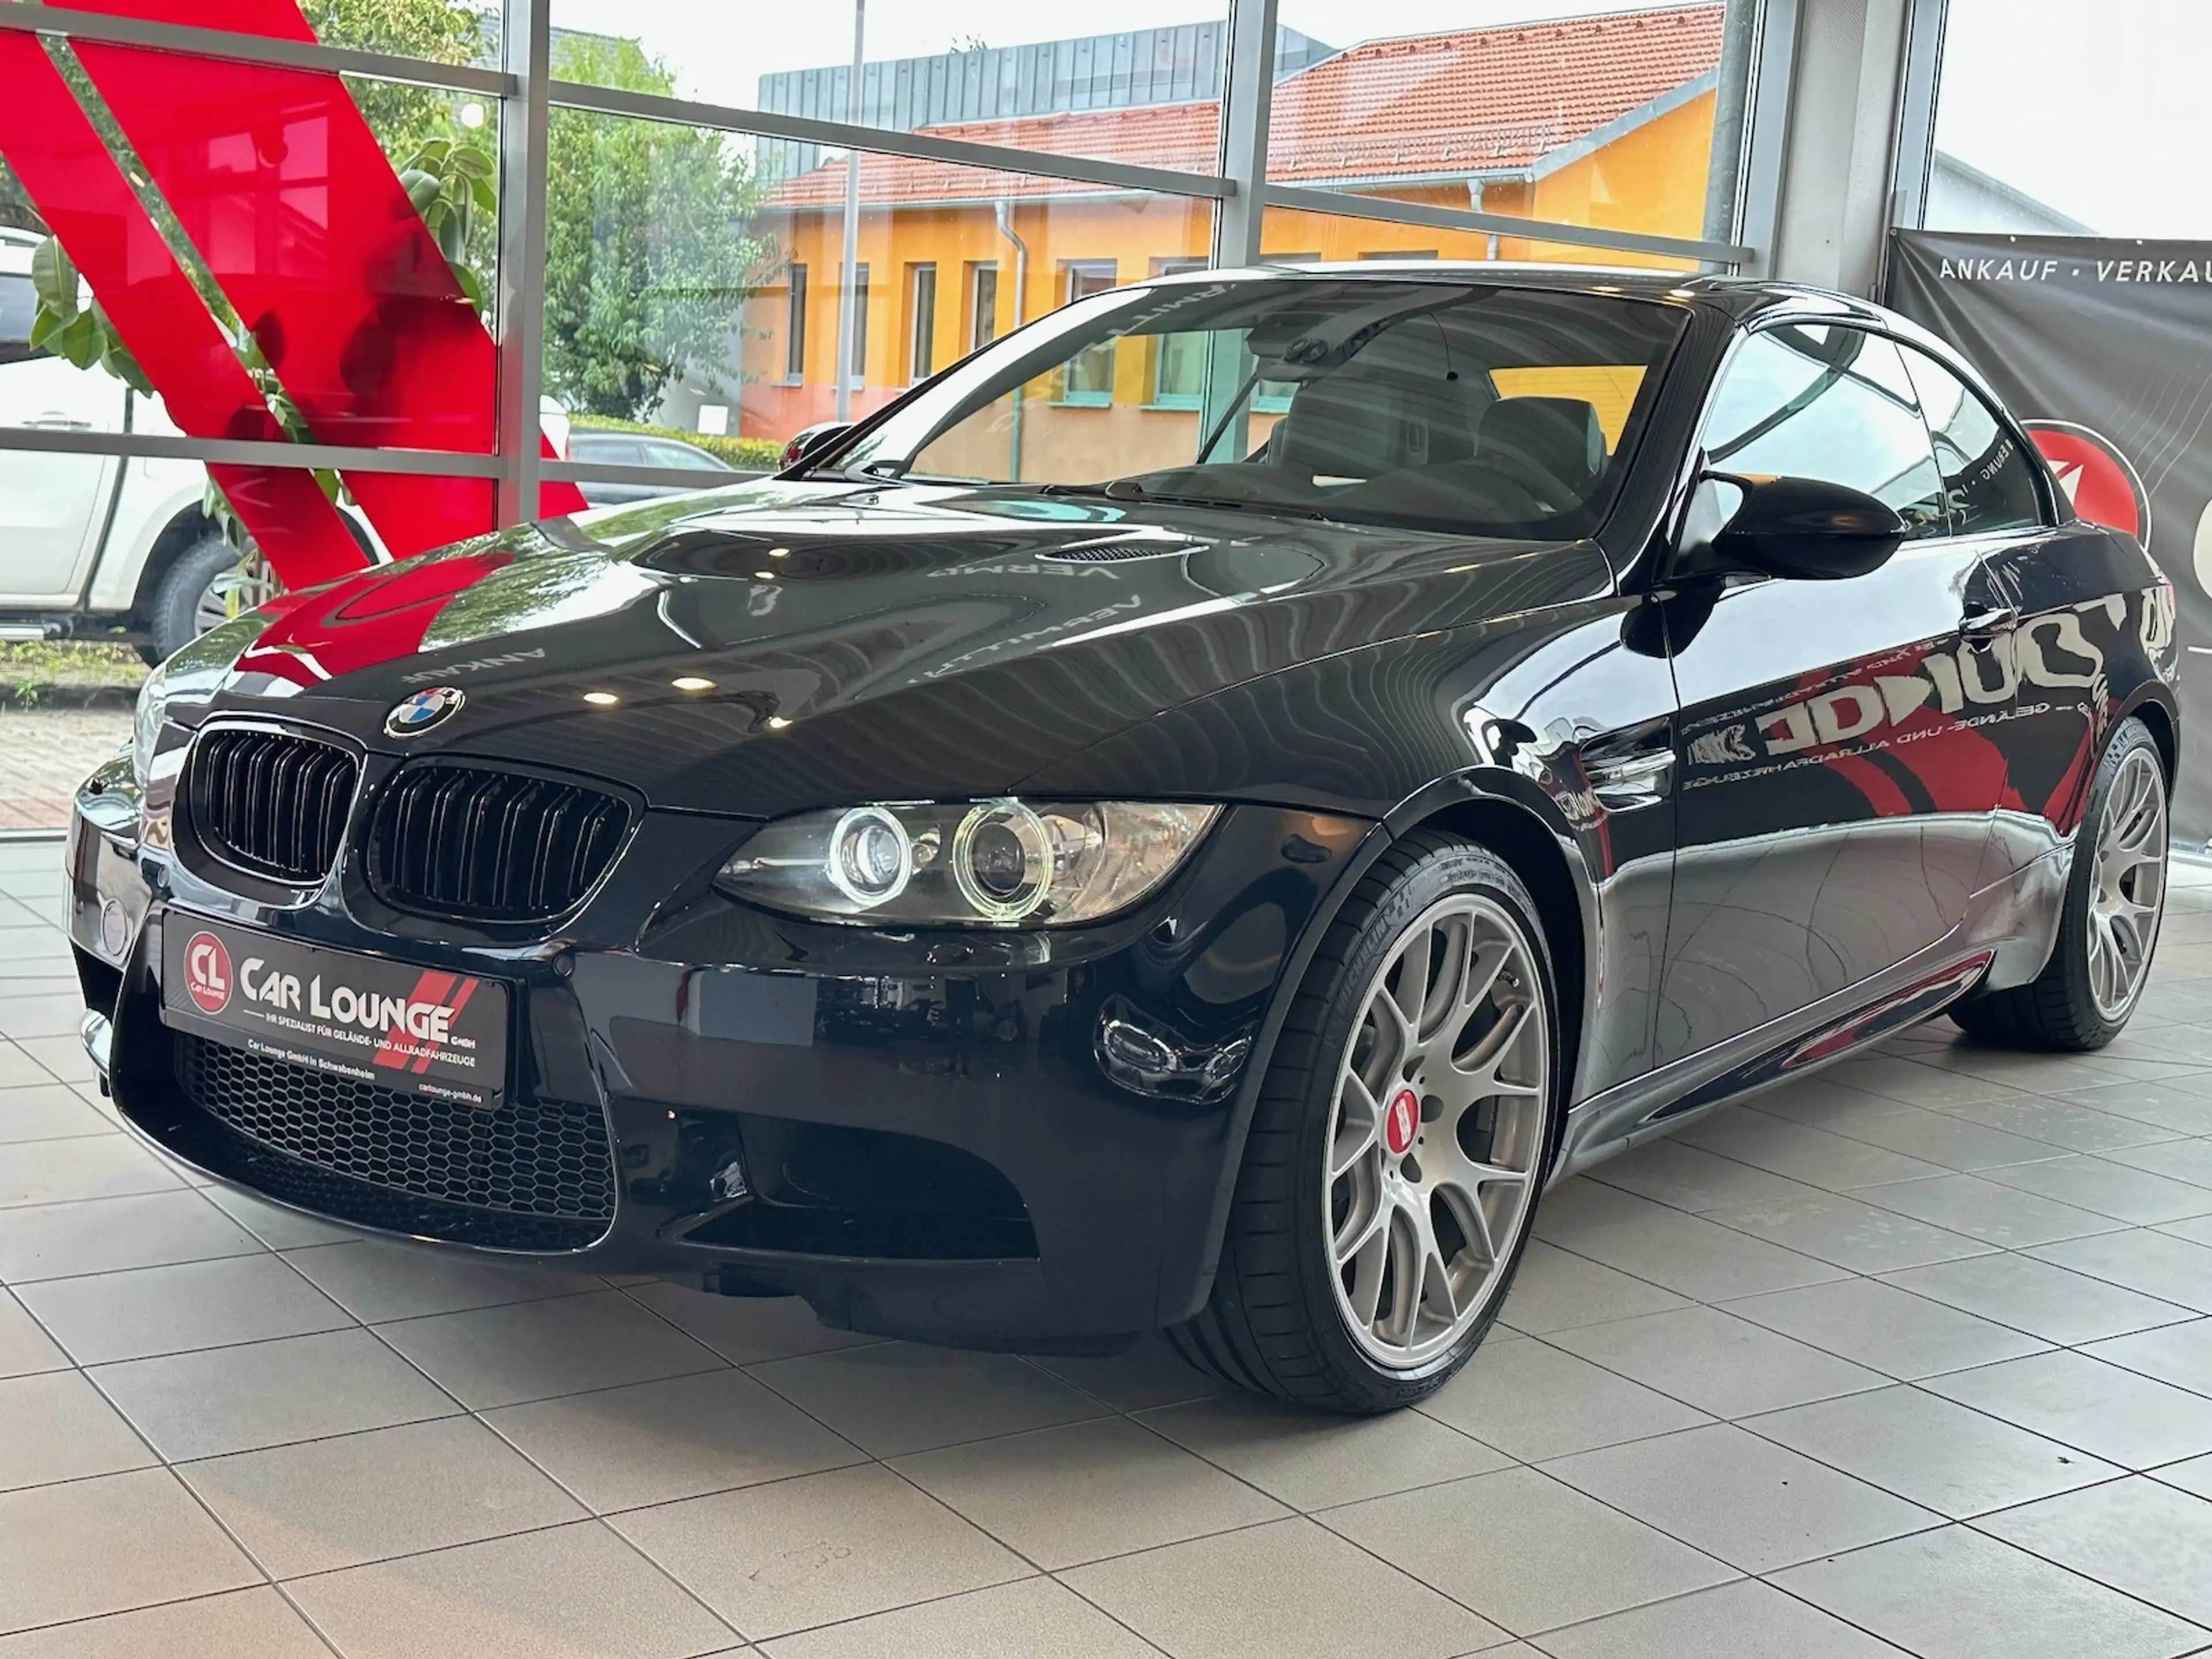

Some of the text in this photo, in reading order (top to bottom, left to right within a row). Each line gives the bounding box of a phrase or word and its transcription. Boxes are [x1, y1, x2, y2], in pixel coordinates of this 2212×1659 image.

[1940, 259, 2058, 281] ANKAUF
[191, 944, 225, 990] CL
[247, 1038, 375, 1080] Car Lounge GmbH in Schwabenheim
[266, 1012, 476, 1067] IHR SPEZIALIST FÜR GELÄNDE- UND ALLRADFAHRZEUGE
